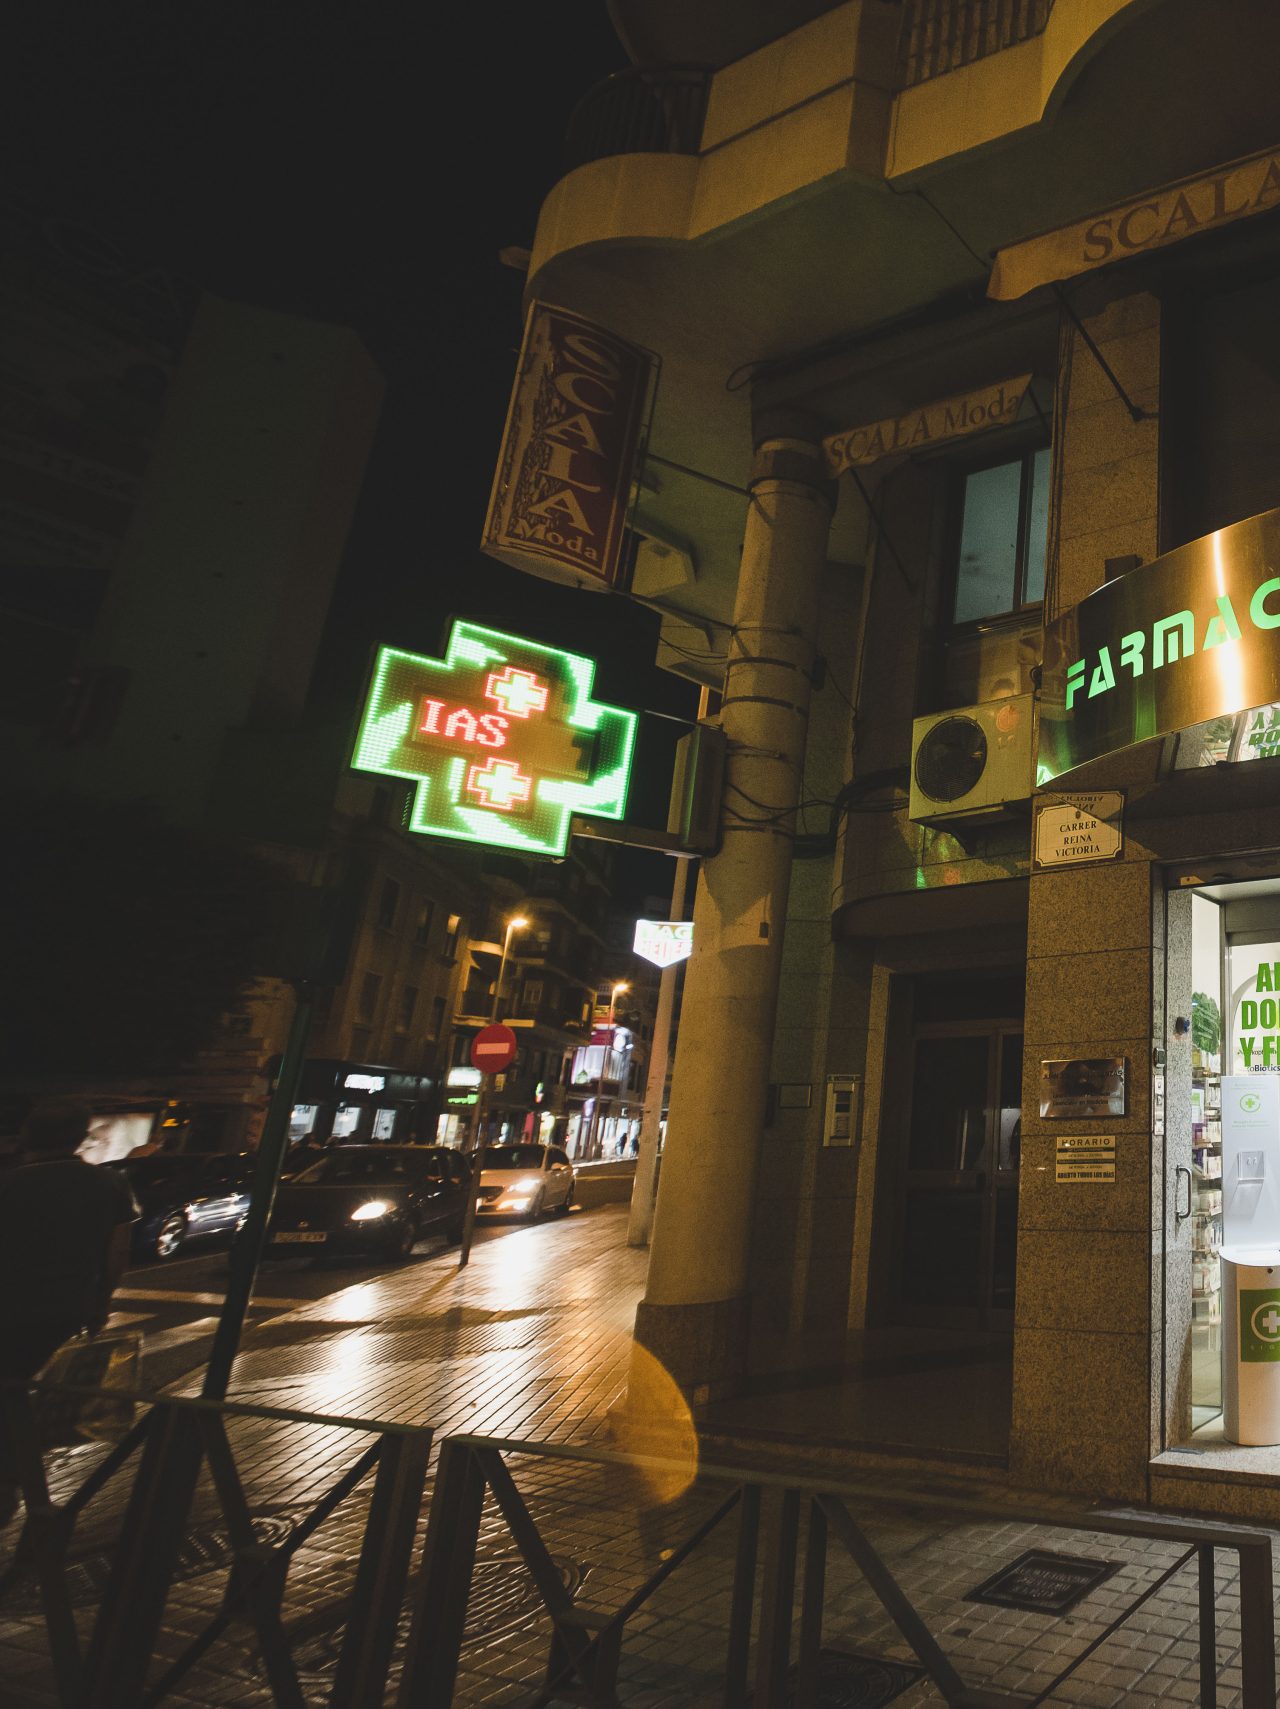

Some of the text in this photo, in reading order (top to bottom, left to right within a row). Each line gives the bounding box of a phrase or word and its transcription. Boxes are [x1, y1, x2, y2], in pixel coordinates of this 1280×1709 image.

[527, 334, 620, 536] SCALA
[830, 411, 932, 465] SCALA
[512, 517, 598, 560] Moda
[419, 699, 510, 747] IAS
[1060, 820, 1097, 833] CARRER
[1063, 834, 1092, 845] REINA
[1055, 845, 1100, 857] VICTORIA
[1240, 1037, 1255, 1067] Y
[1061, 1138, 1110, 1146] HORARIO
